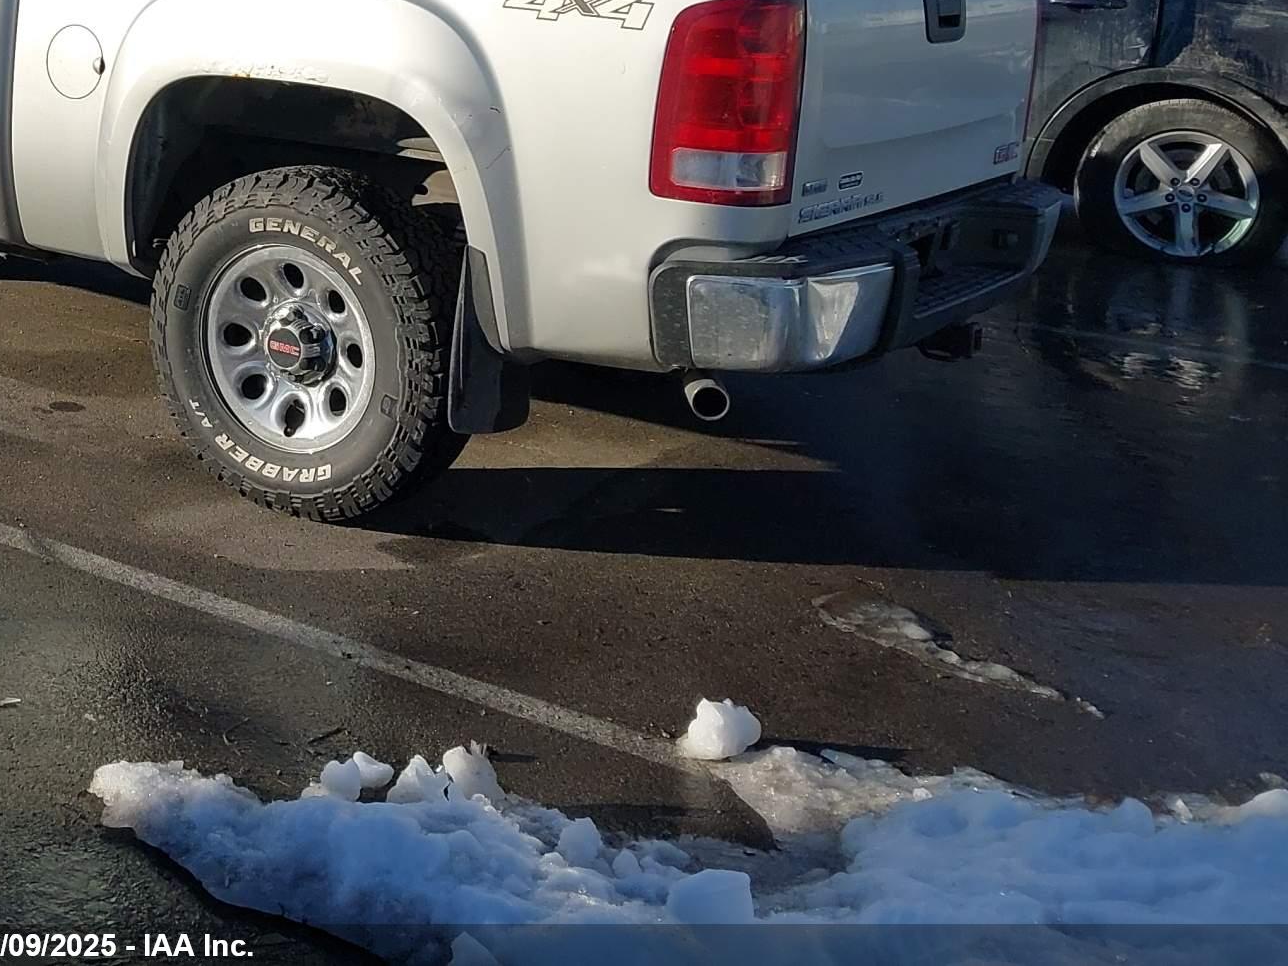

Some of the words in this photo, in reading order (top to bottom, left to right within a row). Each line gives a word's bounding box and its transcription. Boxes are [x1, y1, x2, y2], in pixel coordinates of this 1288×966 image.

[248, 217, 363, 286] GENERAL
[189, 398, 213, 428] A/T
[214, 432, 332, 483] GRABBER
